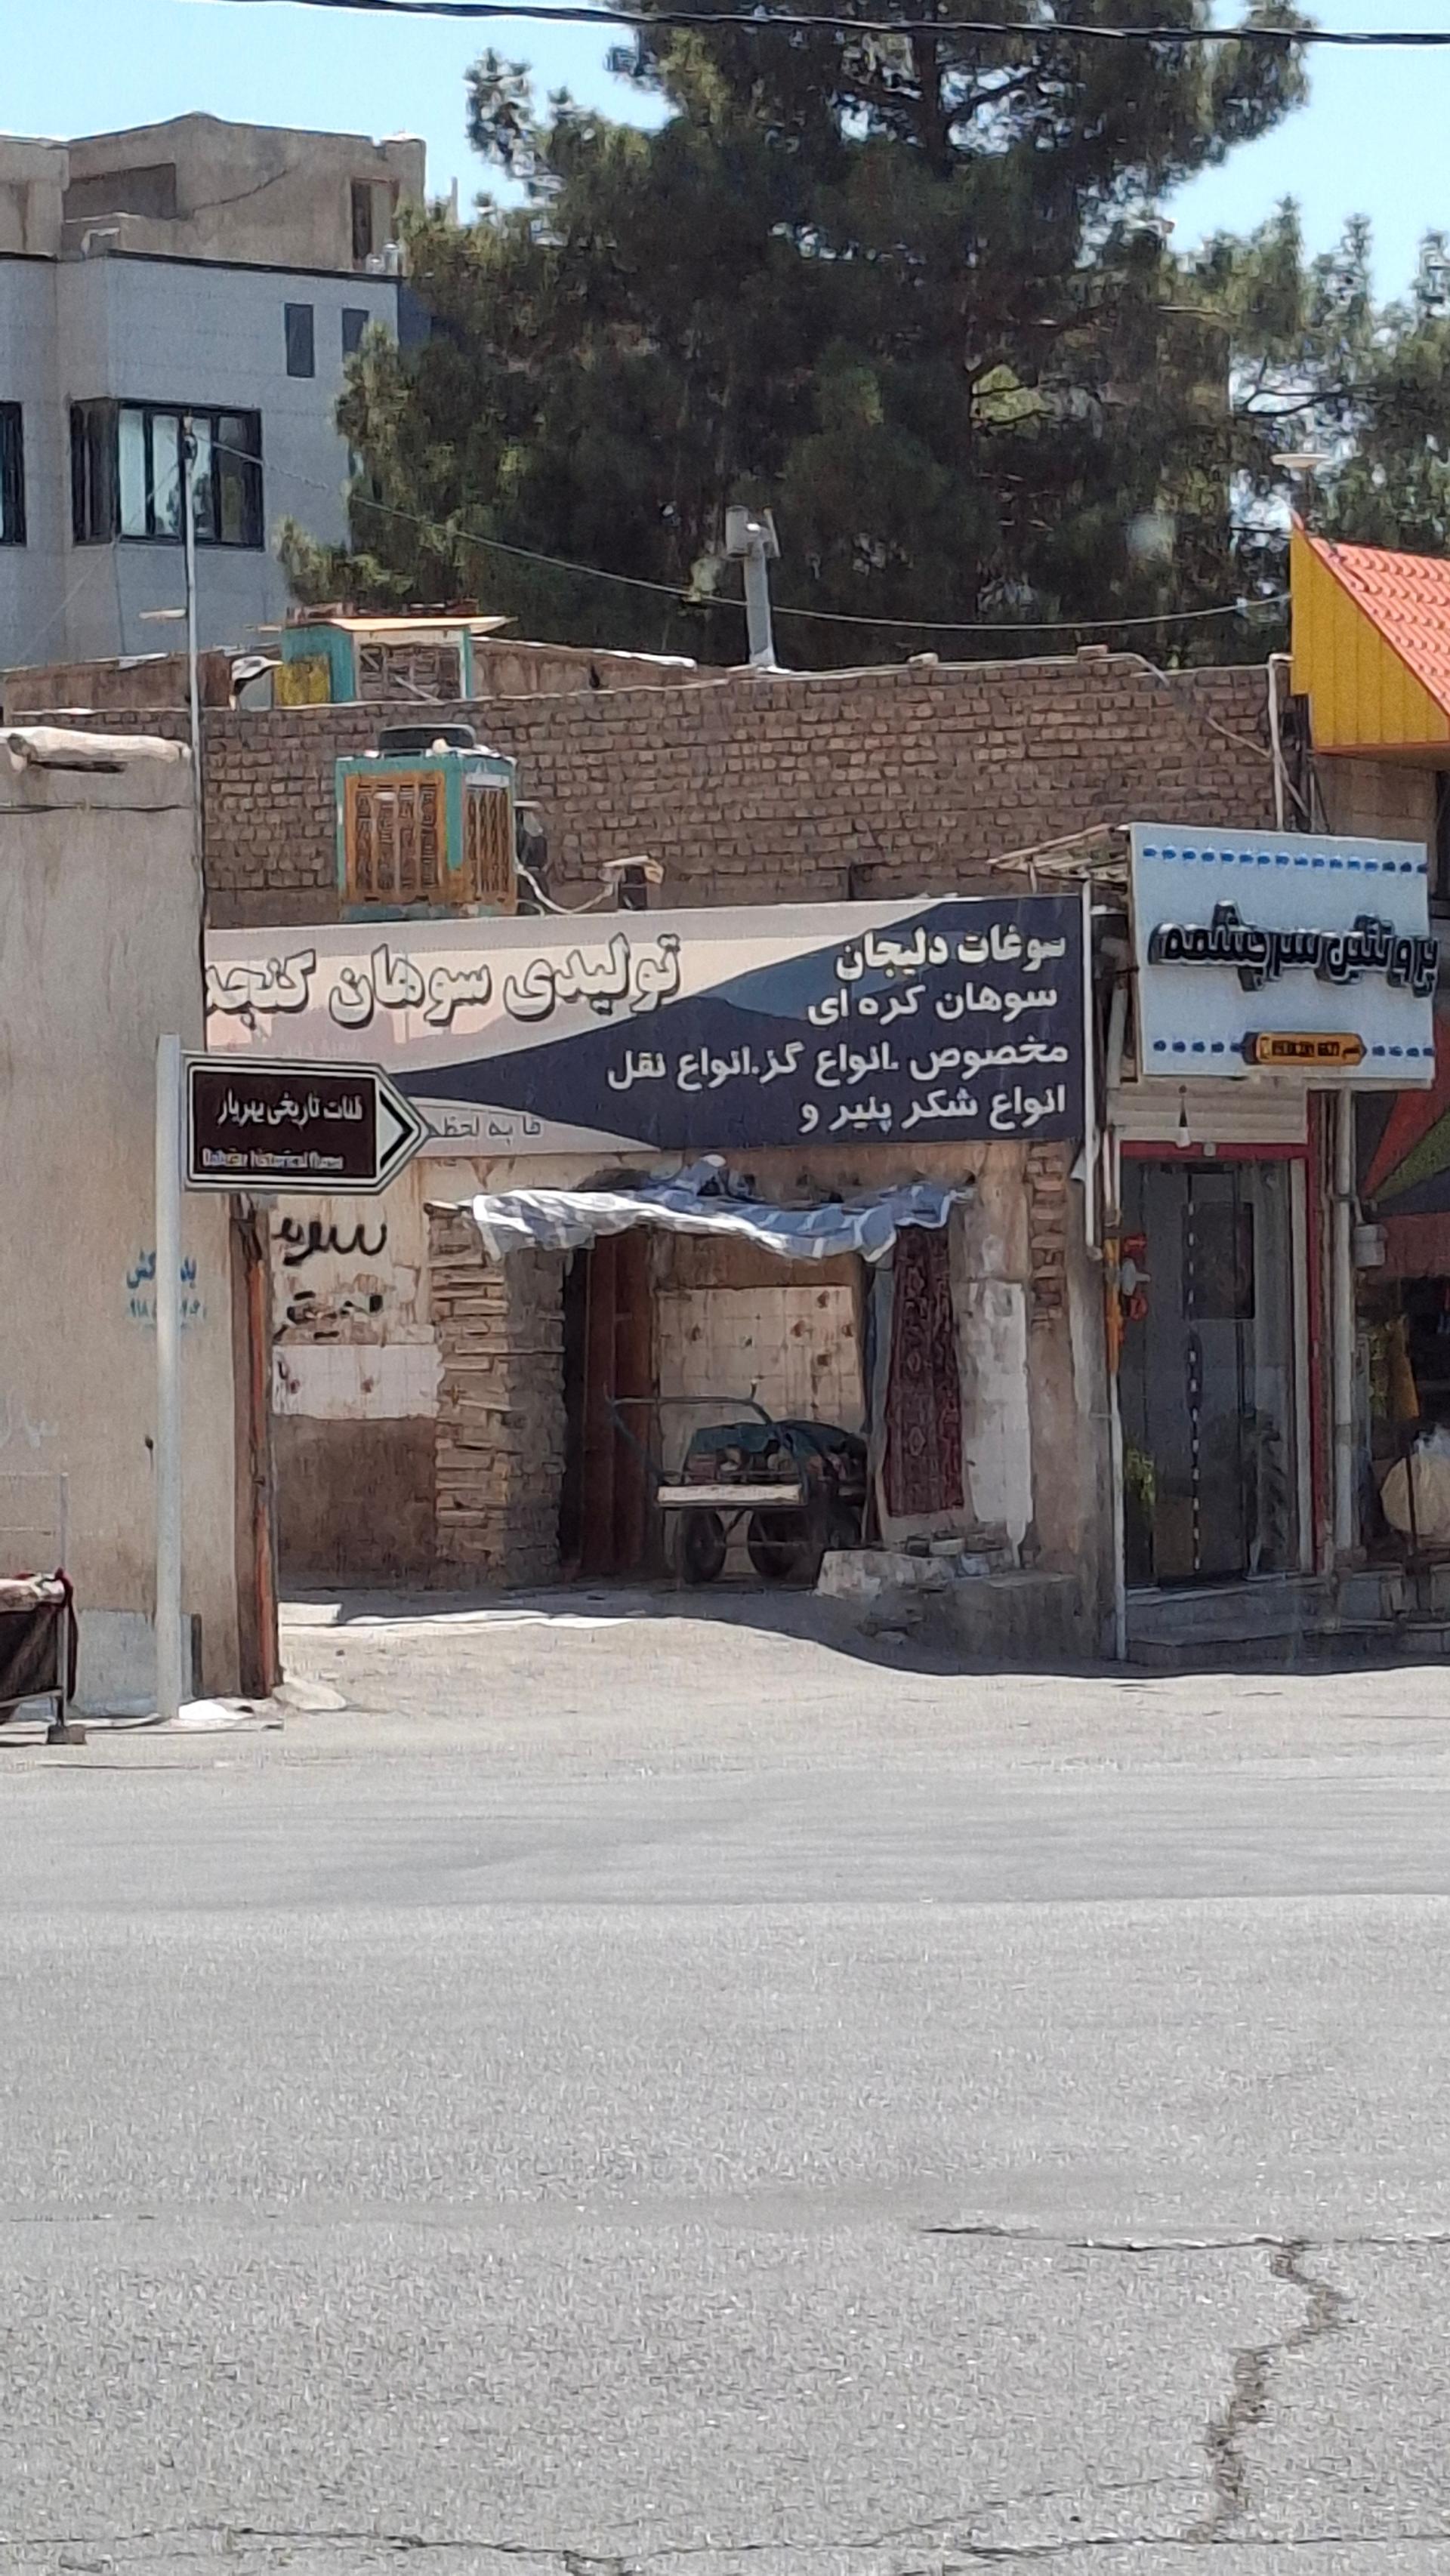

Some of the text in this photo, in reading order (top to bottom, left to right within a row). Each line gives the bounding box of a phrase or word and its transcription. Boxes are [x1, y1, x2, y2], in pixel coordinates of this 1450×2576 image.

[503, 932, 681, 1022] تولیدی
[835, 923, 1066, 981] سوغات دلیجان
[329, 942, 492, 1029] سوهان
[807, 981, 1057, 1026] سوهان کره ای
[607, 1049, 666, 1090] نقل
[910, 1034, 1068, 1081] مخصوص
[799, 1084, 1066, 1134] انواع شکر پنیر و
